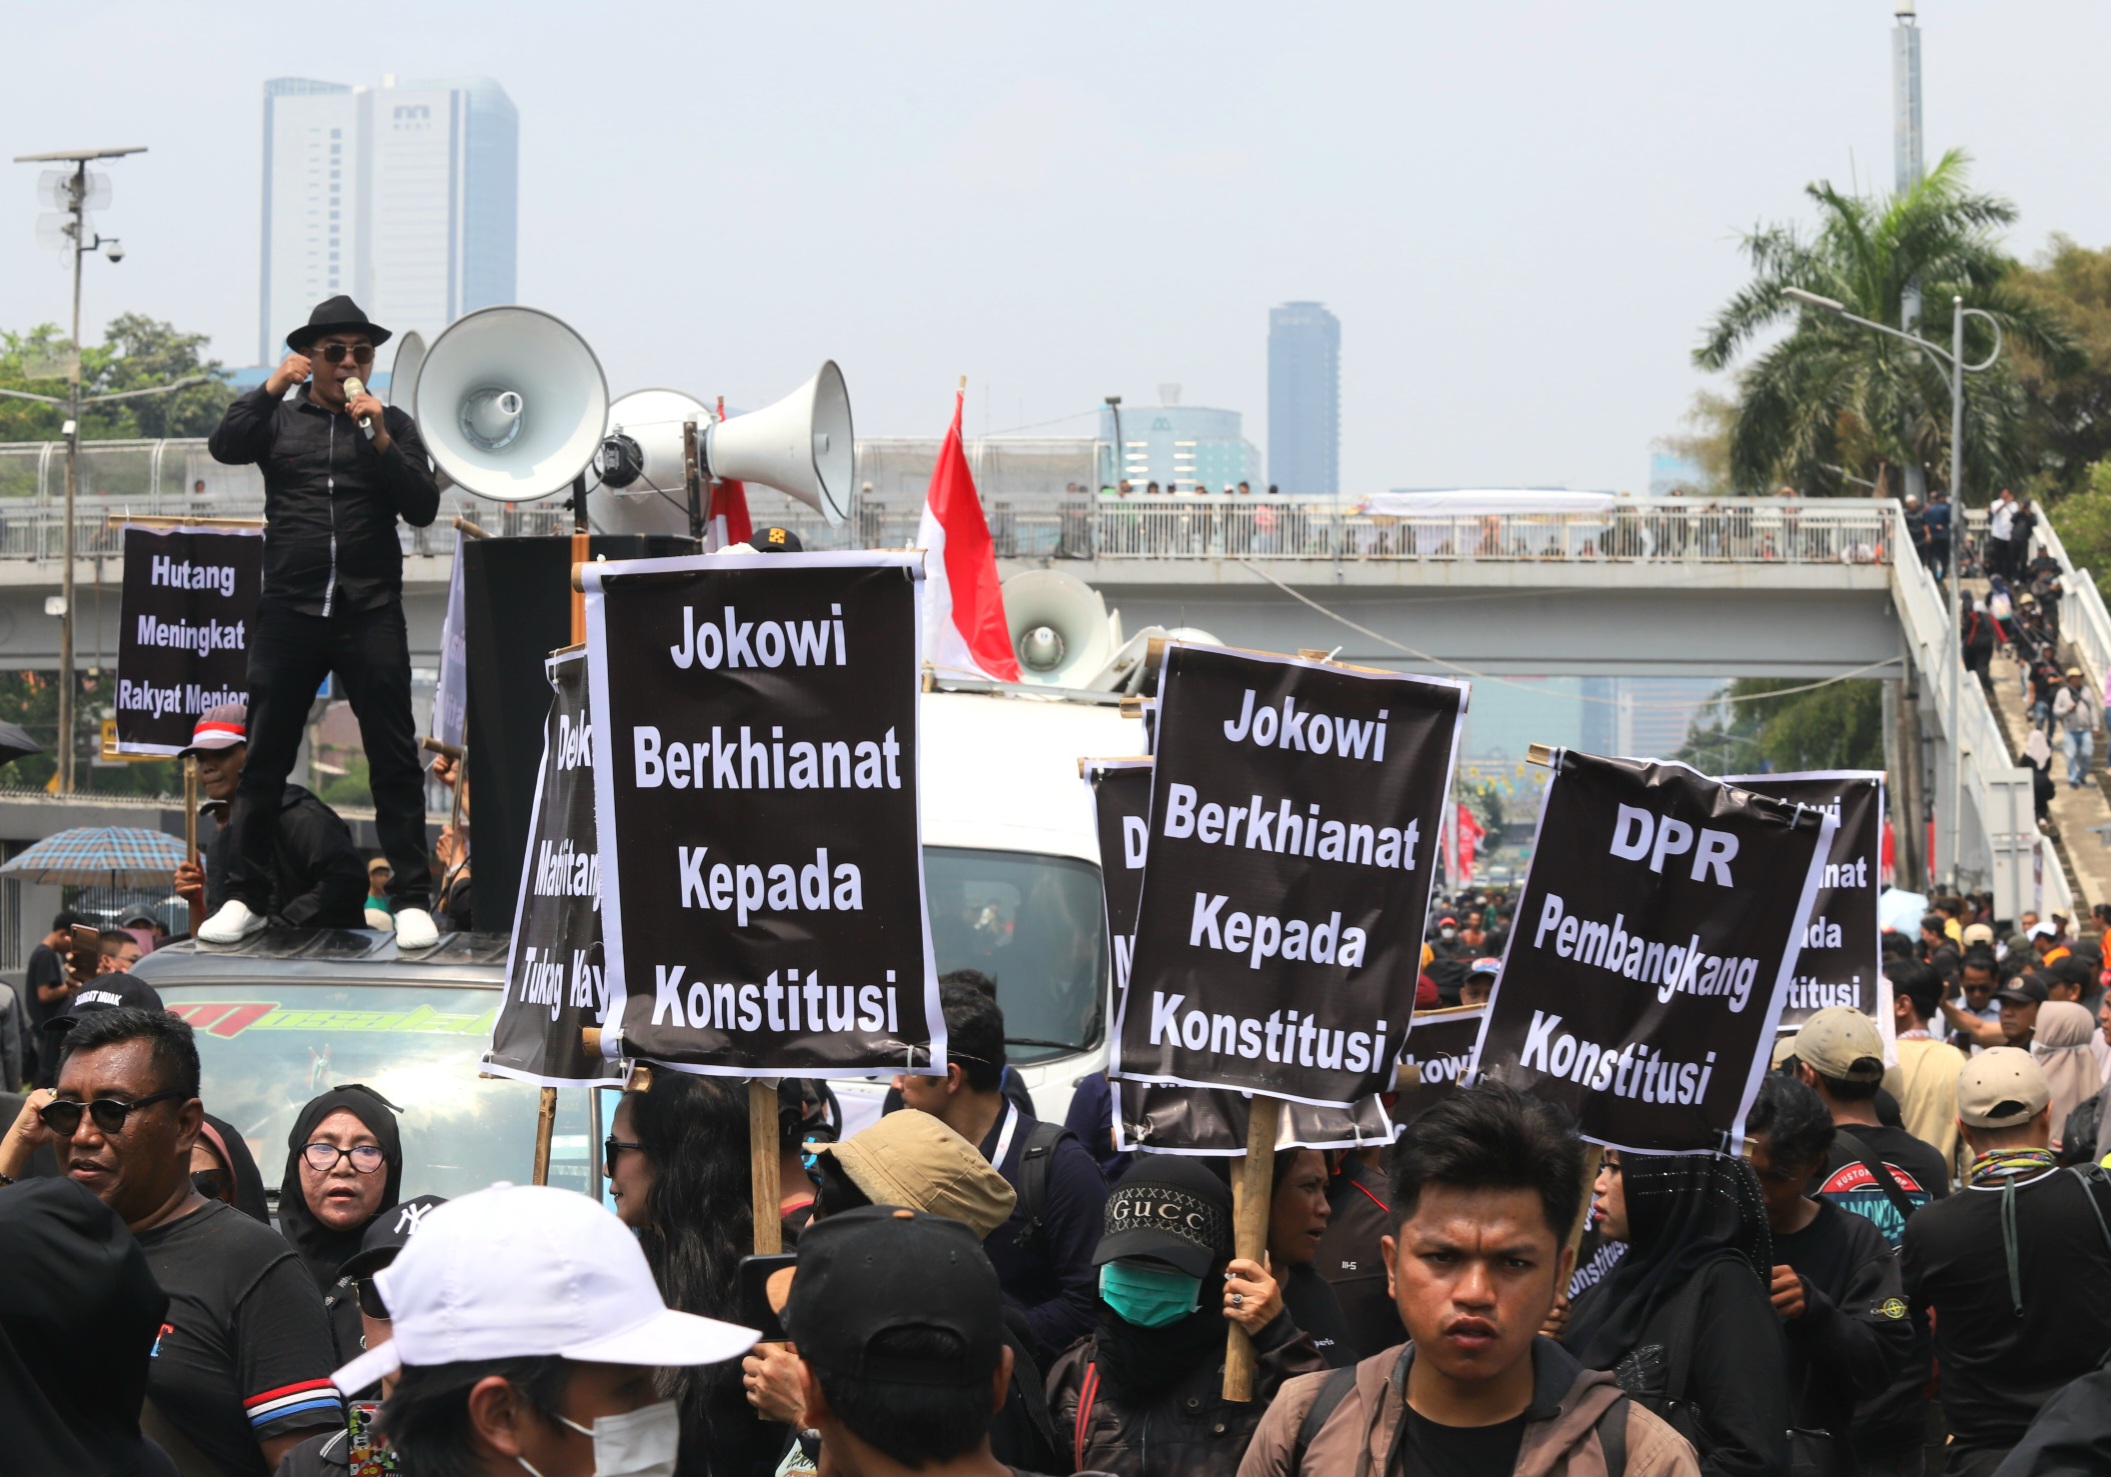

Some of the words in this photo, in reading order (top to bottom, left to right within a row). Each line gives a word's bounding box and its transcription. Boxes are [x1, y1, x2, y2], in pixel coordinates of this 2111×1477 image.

[151, 555, 235, 597] Hutang
[137, 615, 245, 657] Meningkat
[671, 603, 846, 669] Jokowi
[119, 679, 181, 719] Rakyat
[1224, 689, 1388, 761] Jokowi
[630, 726, 902, 789] Berkhianat
[1164, 783, 1420, 870] Berkhianat
[1609, 803, 1740, 888] DPR
[679, 846, 863, 926] Kepada
[1190, 892, 1366, 969] Kepada
[1534, 893, 1758, 1012] Pembangkang
[650, 965, 900, 1033] Konstitusi
[1786, 976, 1860, 1010] titusi
[1150, 991, 1386, 1073] Konstitusi
[1519, 1010, 1716, 1105] Konstitusi
[1567, 1240, 1629, 1299] onstitus
